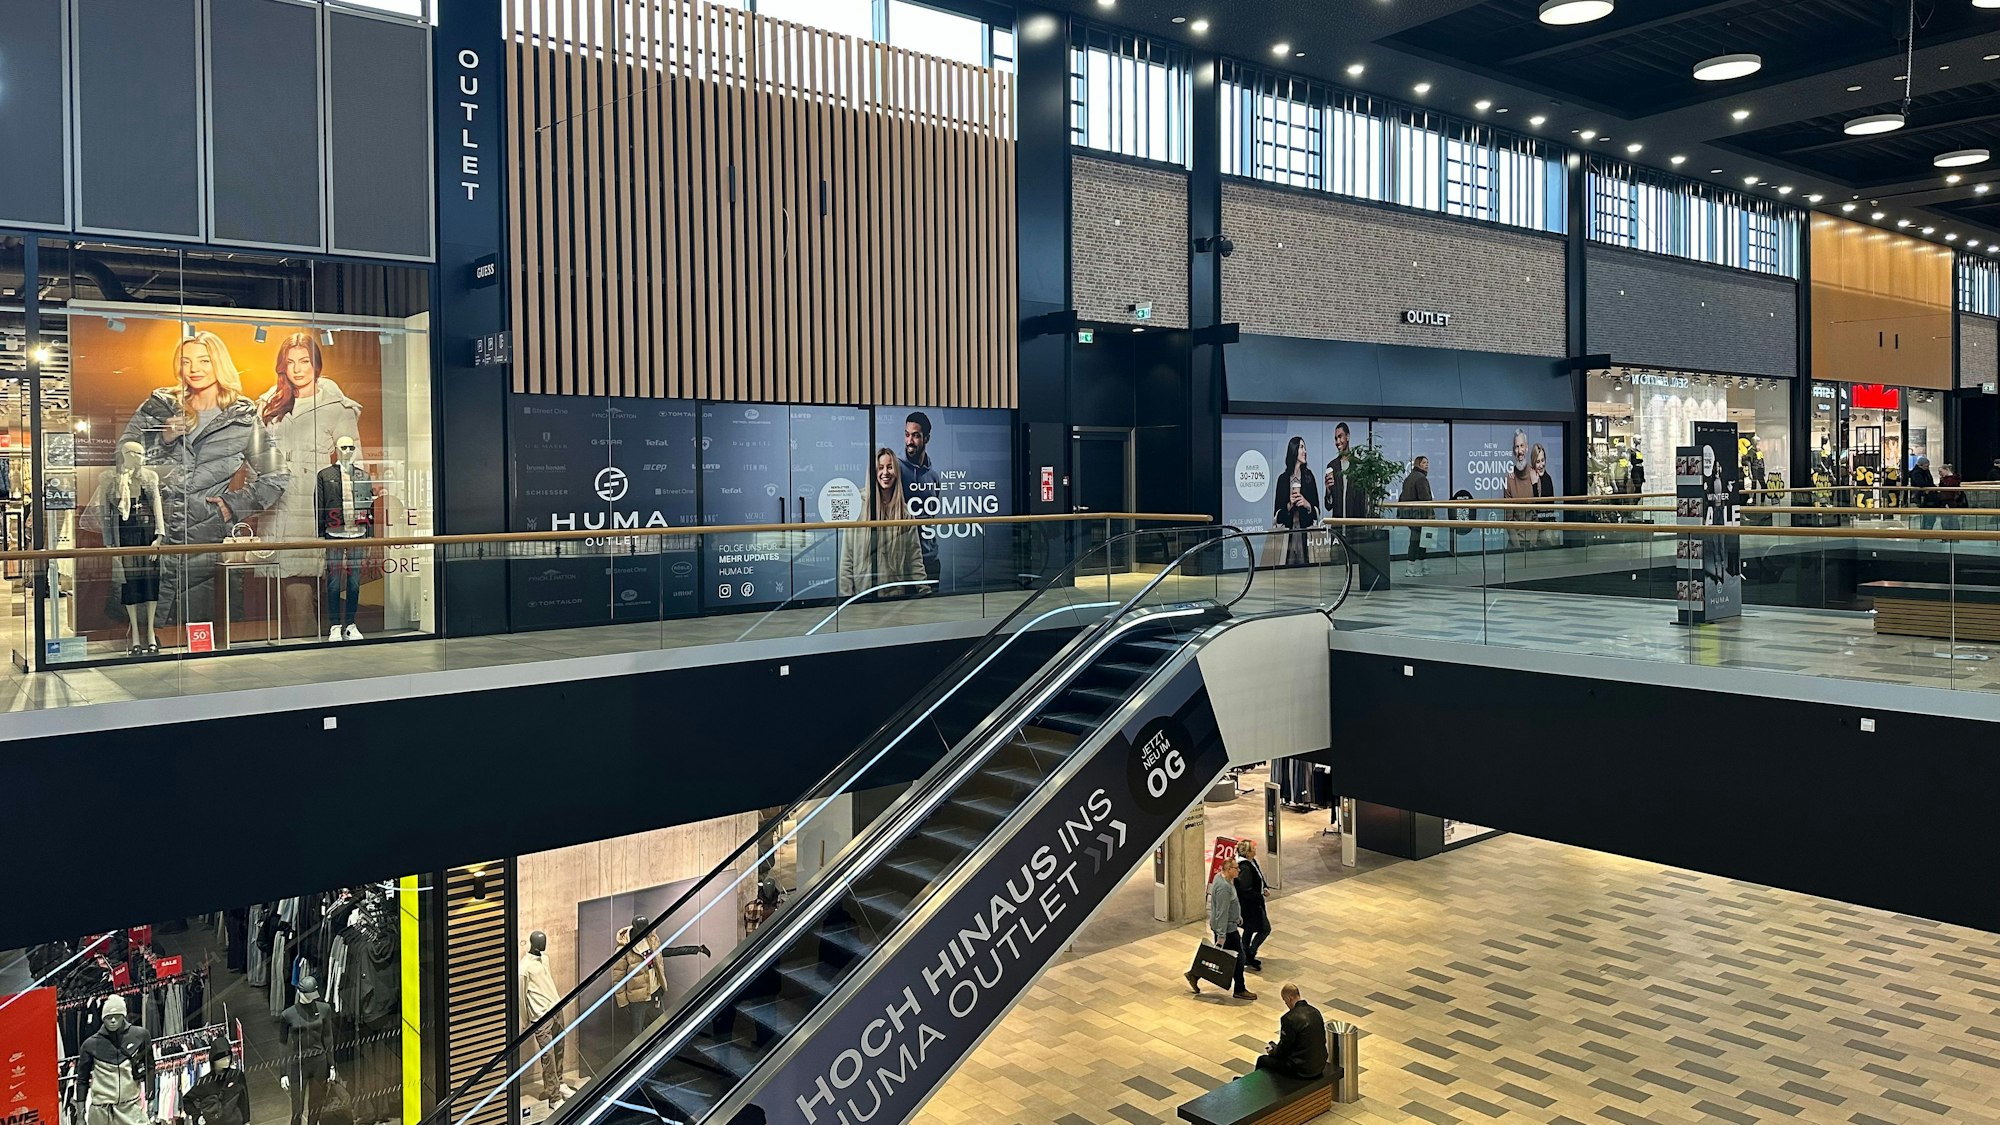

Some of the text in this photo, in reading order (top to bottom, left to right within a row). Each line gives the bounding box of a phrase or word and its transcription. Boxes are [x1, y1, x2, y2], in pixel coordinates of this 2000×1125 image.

[458, 49, 479, 201] OUTLET
[476, 263, 495, 279] GUESS
[1407, 310, 1451, 326] OUTLET
[1467, 460, 1515, 474] COMING
[940, 471, 967, 479] NEW
[909, 481, 996, 492] OUTLET STORE
[1474, 476, 1508, 490] SOON
[45, 491, 76, 499] SALE
[1707, 492, 1730, 501] WINTER
[907, 495, 999, 516] COMING
[551, 510, 669, 531] HUMA
[1705, 505, 1741, 527] ALE
[921, 523, 986, 540] SOON
[585, 536, 640, 547] OUTLET
[719, 544, 744, 553] FOLGE
[745, 543, 761, 552] UNS
[1307, 537, 1340, 547] HUMA
[719, 552, 780, 563] MEHR UPDATES
[1710, 596, 1730, 605] HUMA
[1141, 729, 1165, 760] JETZT
[1143, 738, 1171, 771] NEU IM
[1147, 749, 1186, 798] OG
[133, 924, 147, 932] SALE
[948, 860, 1079, 1018] OUTLET
[161, 959, 177, 967] SALE
[796, 788, 1112, 1124] HOCH HINAUS INS
[115, 966, 126, 976] SALE
